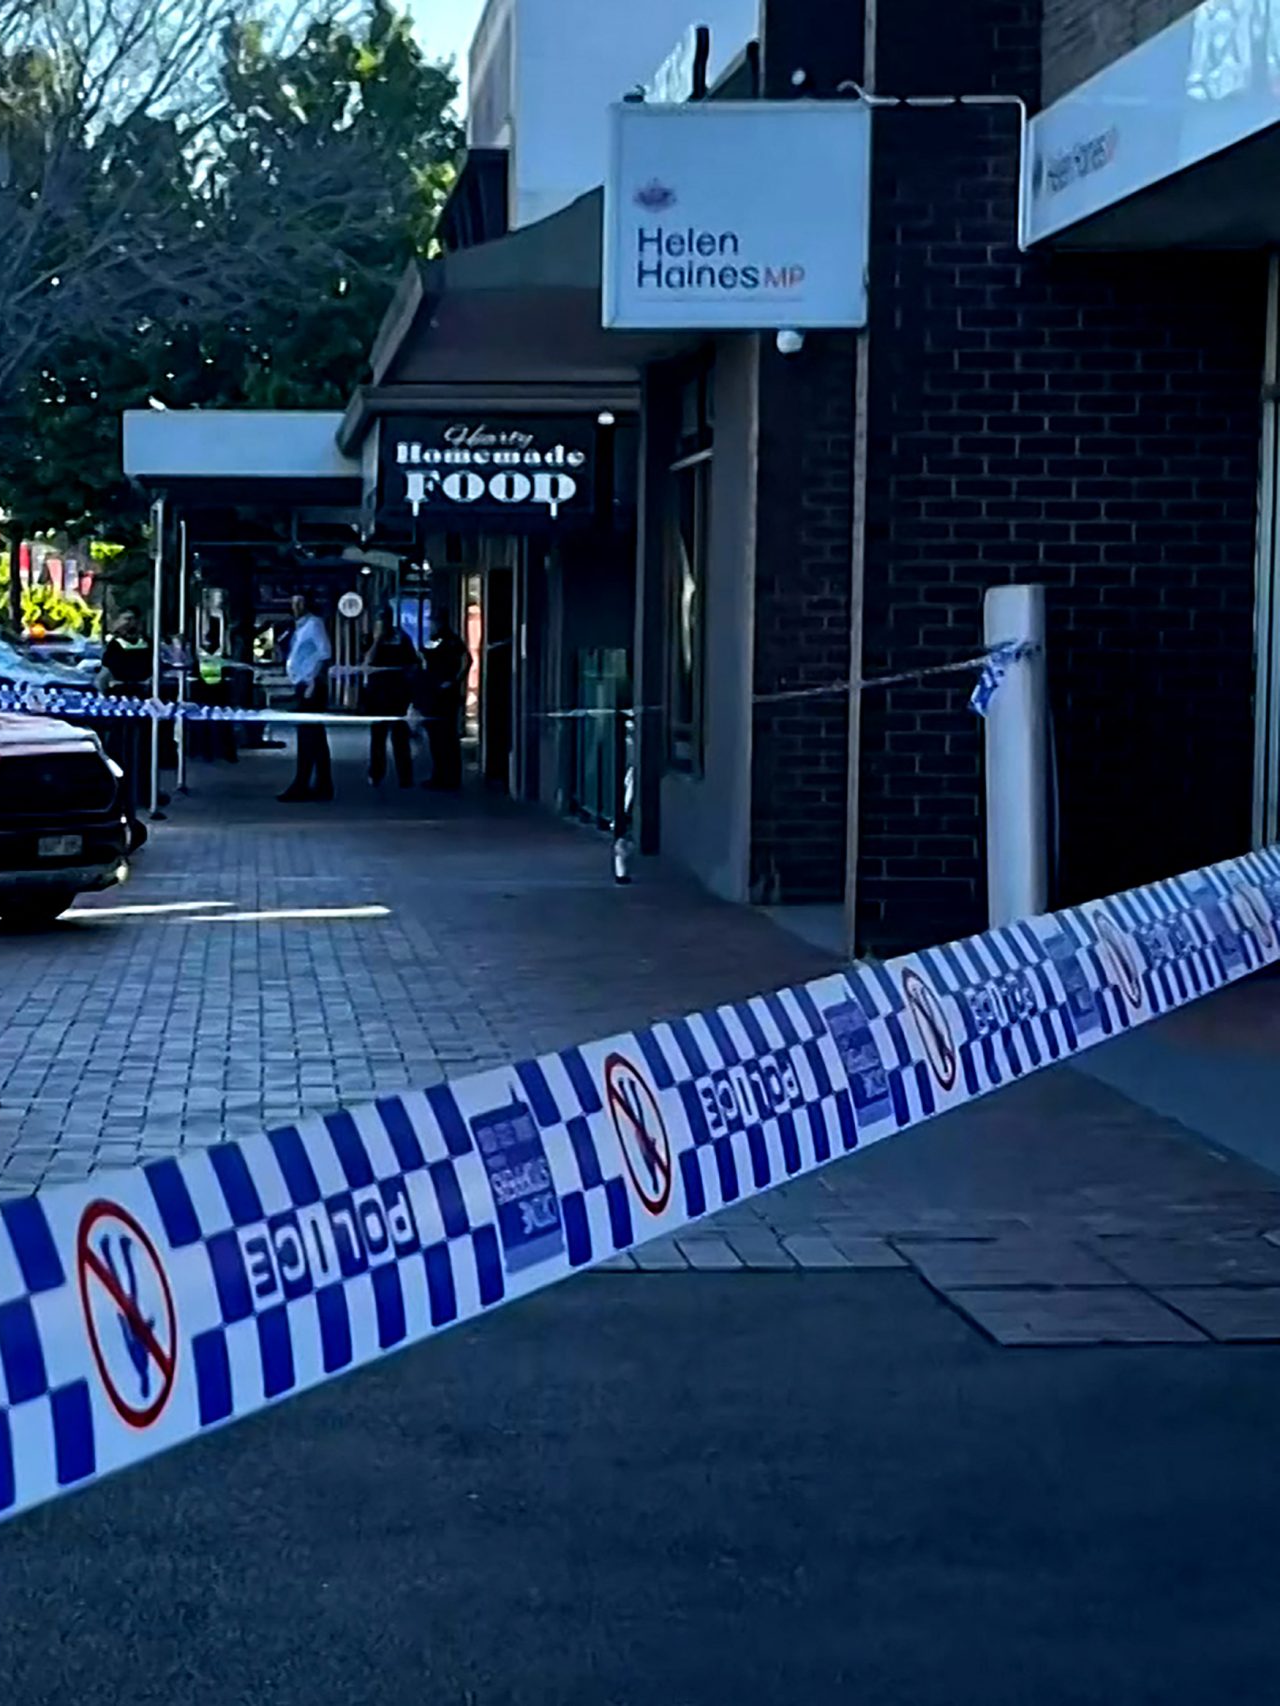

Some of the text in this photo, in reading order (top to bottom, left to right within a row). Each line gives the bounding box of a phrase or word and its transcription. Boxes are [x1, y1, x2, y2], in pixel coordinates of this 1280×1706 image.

[637, 226, 739, 256] Helen
[637, 260, 760, 289] Haines
[396, 441, 585, 467] Homemade
[405, 470, 577, 517] FOOD
[244, 1190, 416, 1297] POLICE
